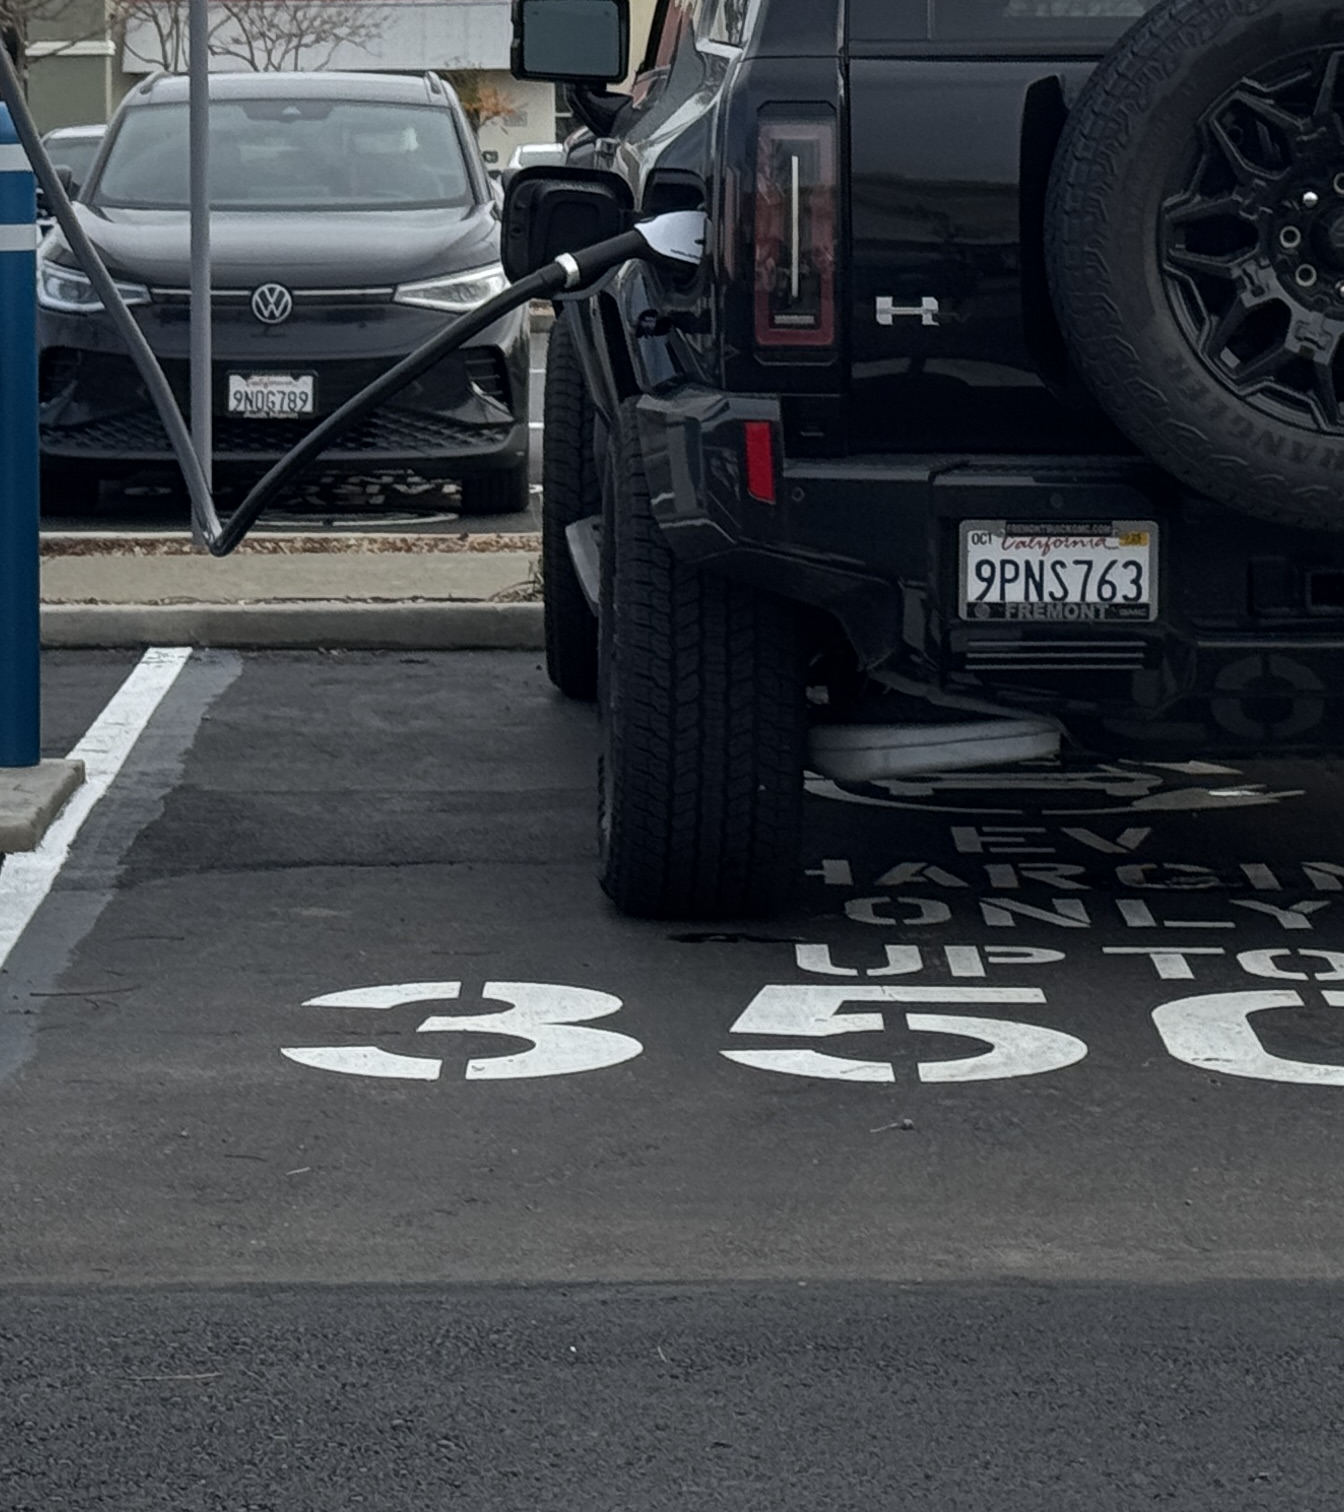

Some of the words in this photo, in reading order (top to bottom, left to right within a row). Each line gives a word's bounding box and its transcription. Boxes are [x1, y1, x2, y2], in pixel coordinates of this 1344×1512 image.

[971, 532, 993, 546] OCT
[1001, 536, 1114, 557] California
[974, 558, 1144, 603] 9PNS763
[1006, 603, 1110, 620] FREMONT
[950, 825, 1153, 854] EV
[843, 896, 1332, 929] ONLY
[794, 943, 1066, 978] UP
